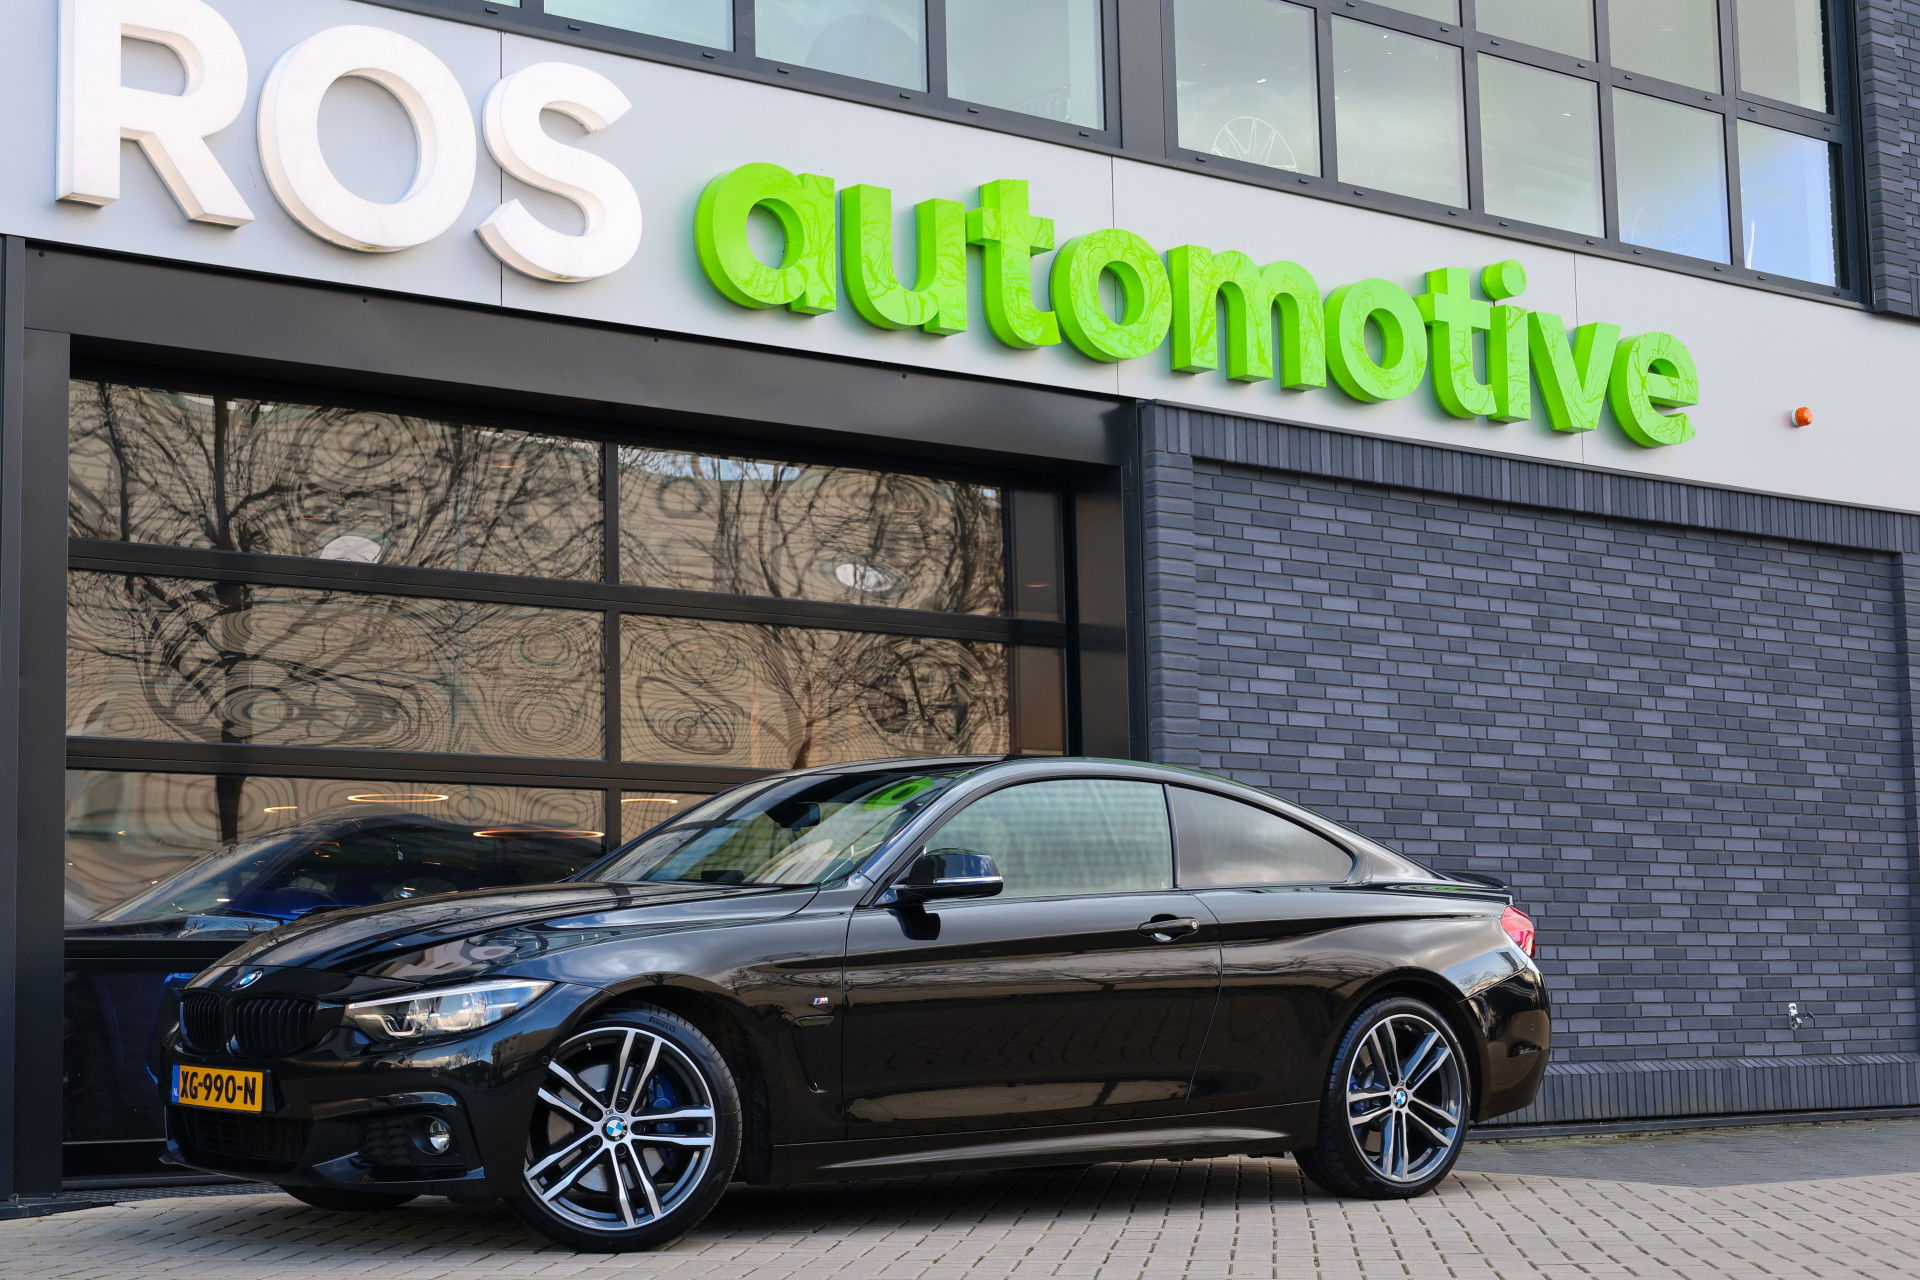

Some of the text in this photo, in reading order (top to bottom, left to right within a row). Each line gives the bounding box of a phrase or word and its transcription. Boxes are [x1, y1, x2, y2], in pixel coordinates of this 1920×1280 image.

[56, 0, 1696, 445] ROS automotive
[180, 1070, 257, 1106] XG-990-N
